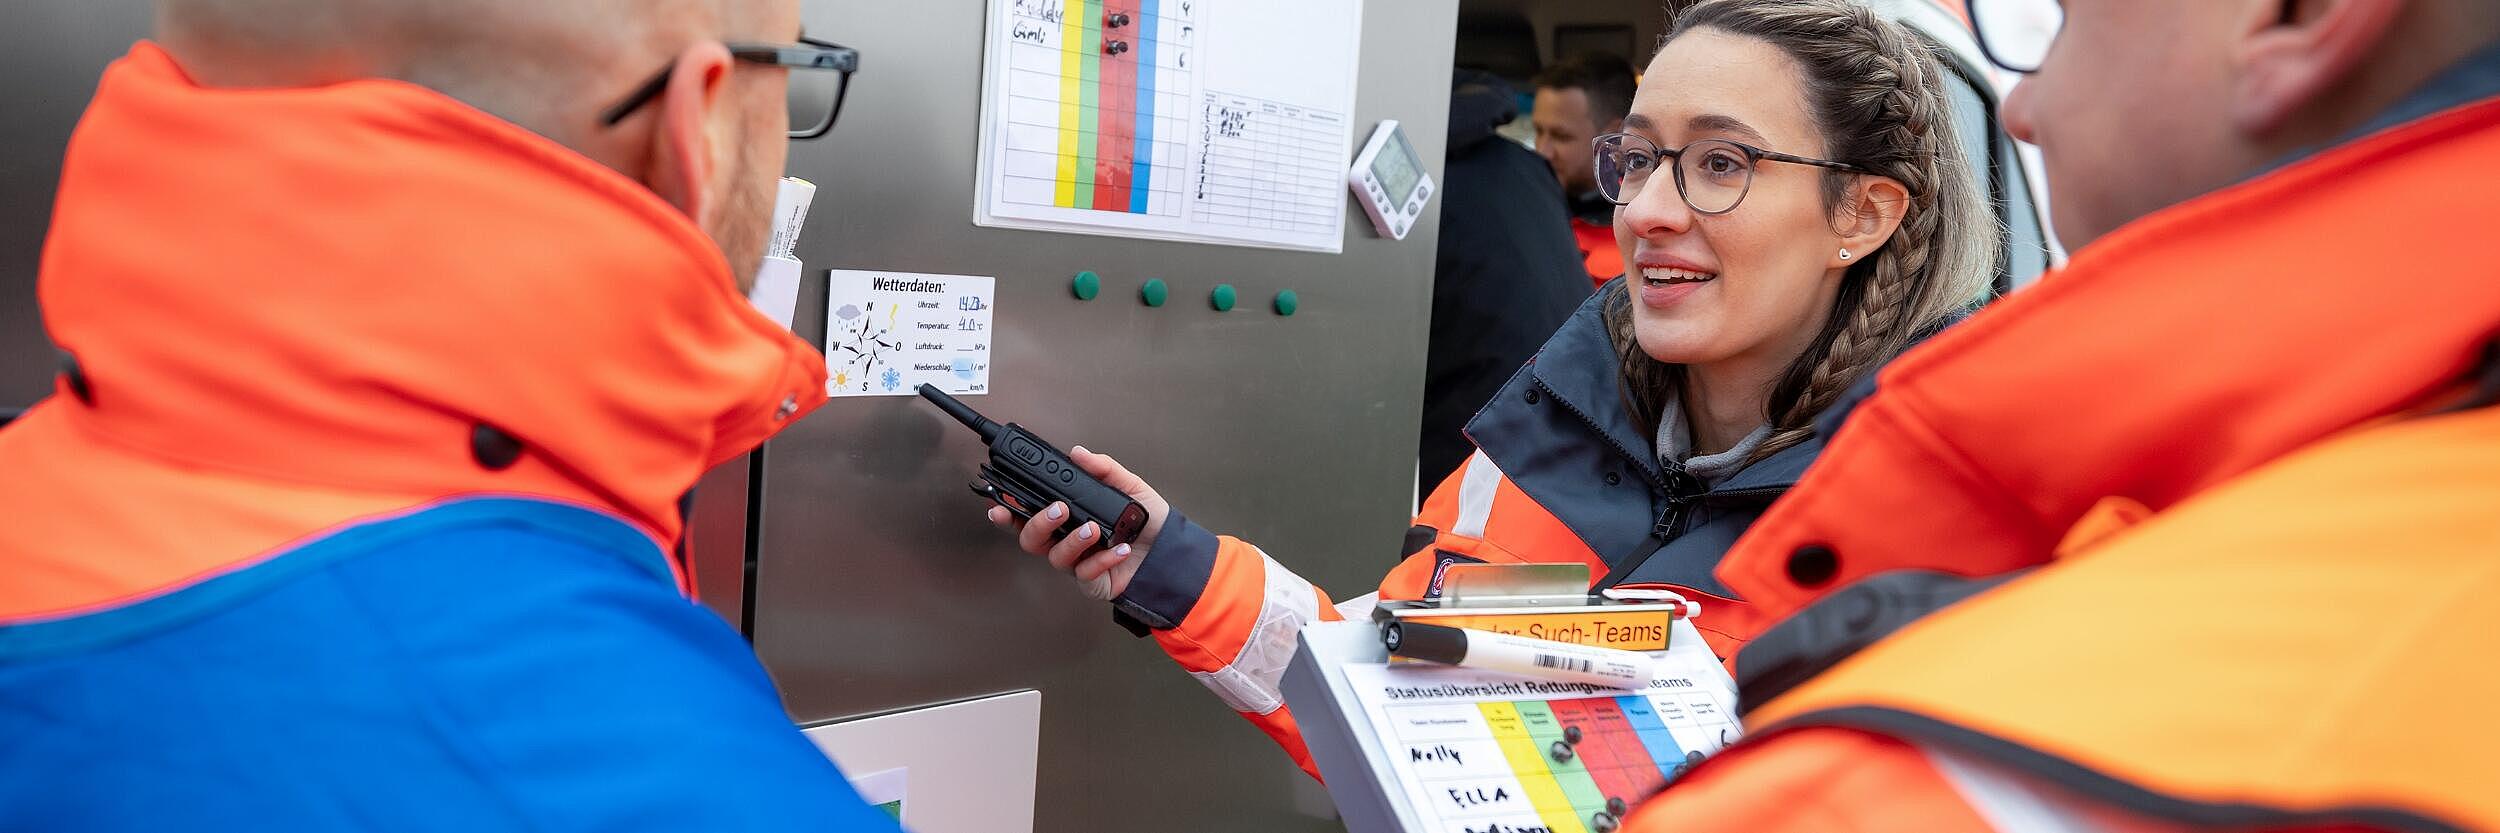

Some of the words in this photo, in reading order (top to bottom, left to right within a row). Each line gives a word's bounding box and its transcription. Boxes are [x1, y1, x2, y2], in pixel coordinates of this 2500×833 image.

[873, 277, 945, 293] Wetterdaten:
[866, 302, 873, 311] N
[918, 301, 939, 309] Uhrzeit:
[917, 322, 950, 330] Temperatur:
[832, 341, 840, 351] W
[895, 342, 902, 351] O
[974, 343, 986, 351] hPa
[914, 363, 952, 372] Niederschlag:
[862, 382, 868, 392] S
[969, 383, 984, 392] km/h
[1529, 621, 1662, 645] Such-Teams
[1384, 681, 1523, 699] Statusübersicht
